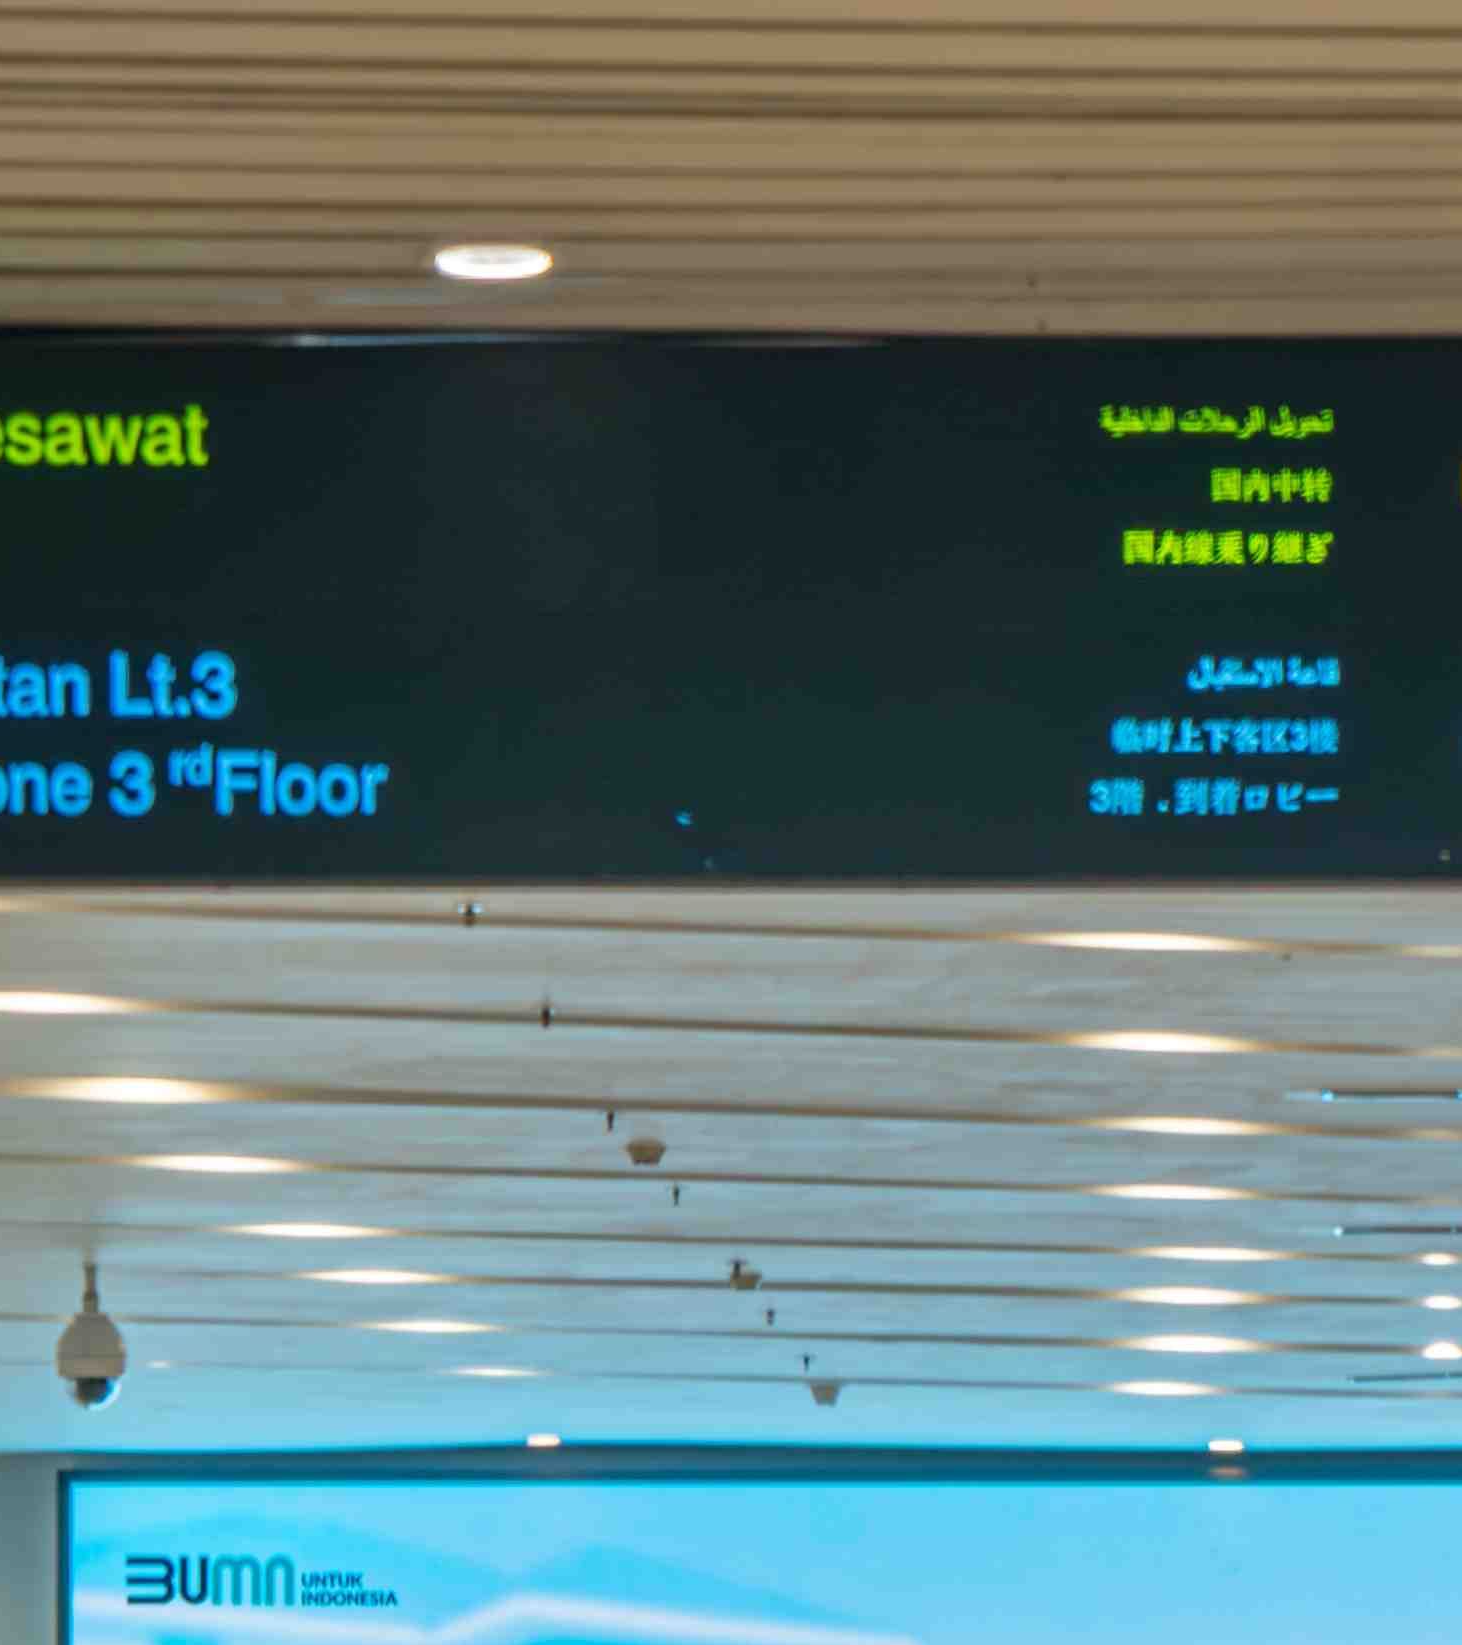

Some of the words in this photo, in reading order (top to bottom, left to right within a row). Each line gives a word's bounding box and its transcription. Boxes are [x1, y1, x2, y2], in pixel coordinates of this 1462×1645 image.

[109, 652, 237, 718] Lt.3
[300, 1571, 364, 1589] UNTUK
[300, 1589, 399, 1607] INDONESIA
